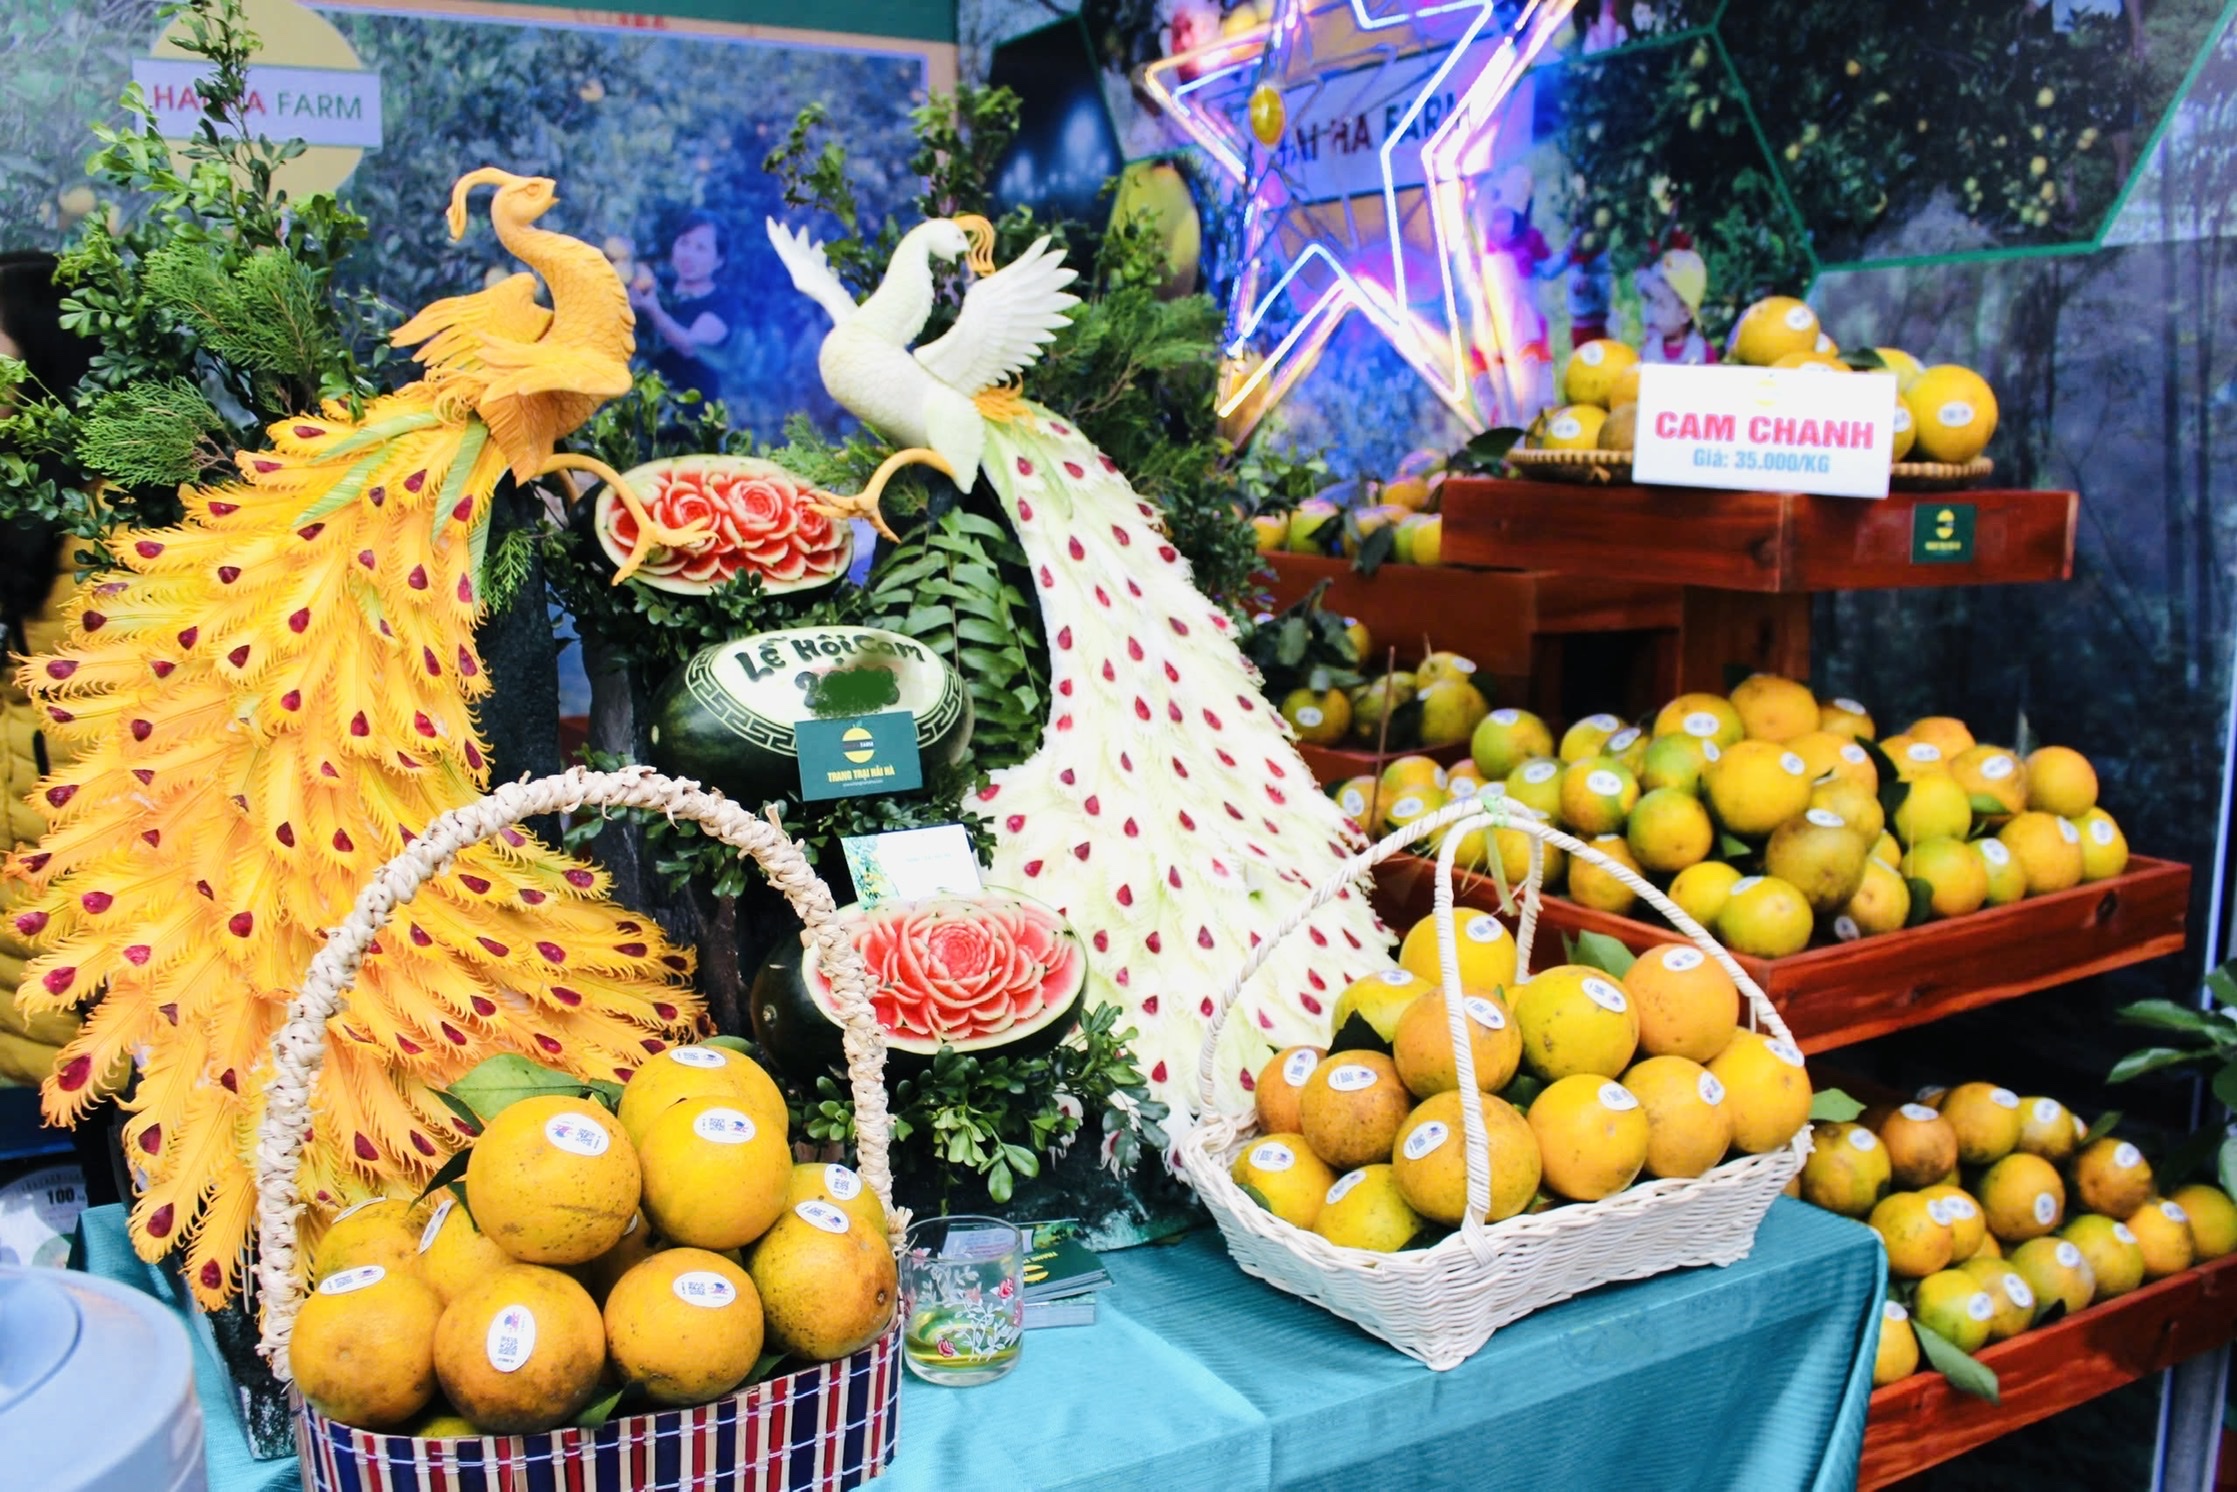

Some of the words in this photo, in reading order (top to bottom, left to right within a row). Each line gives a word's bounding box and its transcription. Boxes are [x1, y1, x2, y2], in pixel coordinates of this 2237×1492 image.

[277, 91, 362, 120] FARM
[1655, 411, 1736, 442] CAM
[1748, 416, 1875, 449] CHANH
[1692, 447, 1729, 468] Giá:
[1734, 449, 1831, 474] 35.000/KG
[735, 636, 788, 682] Lễ
[790, 633, 856, 665] Hội
[853, 634, 926, 662] Cam
[47, 1187, 75, 1205] 100
